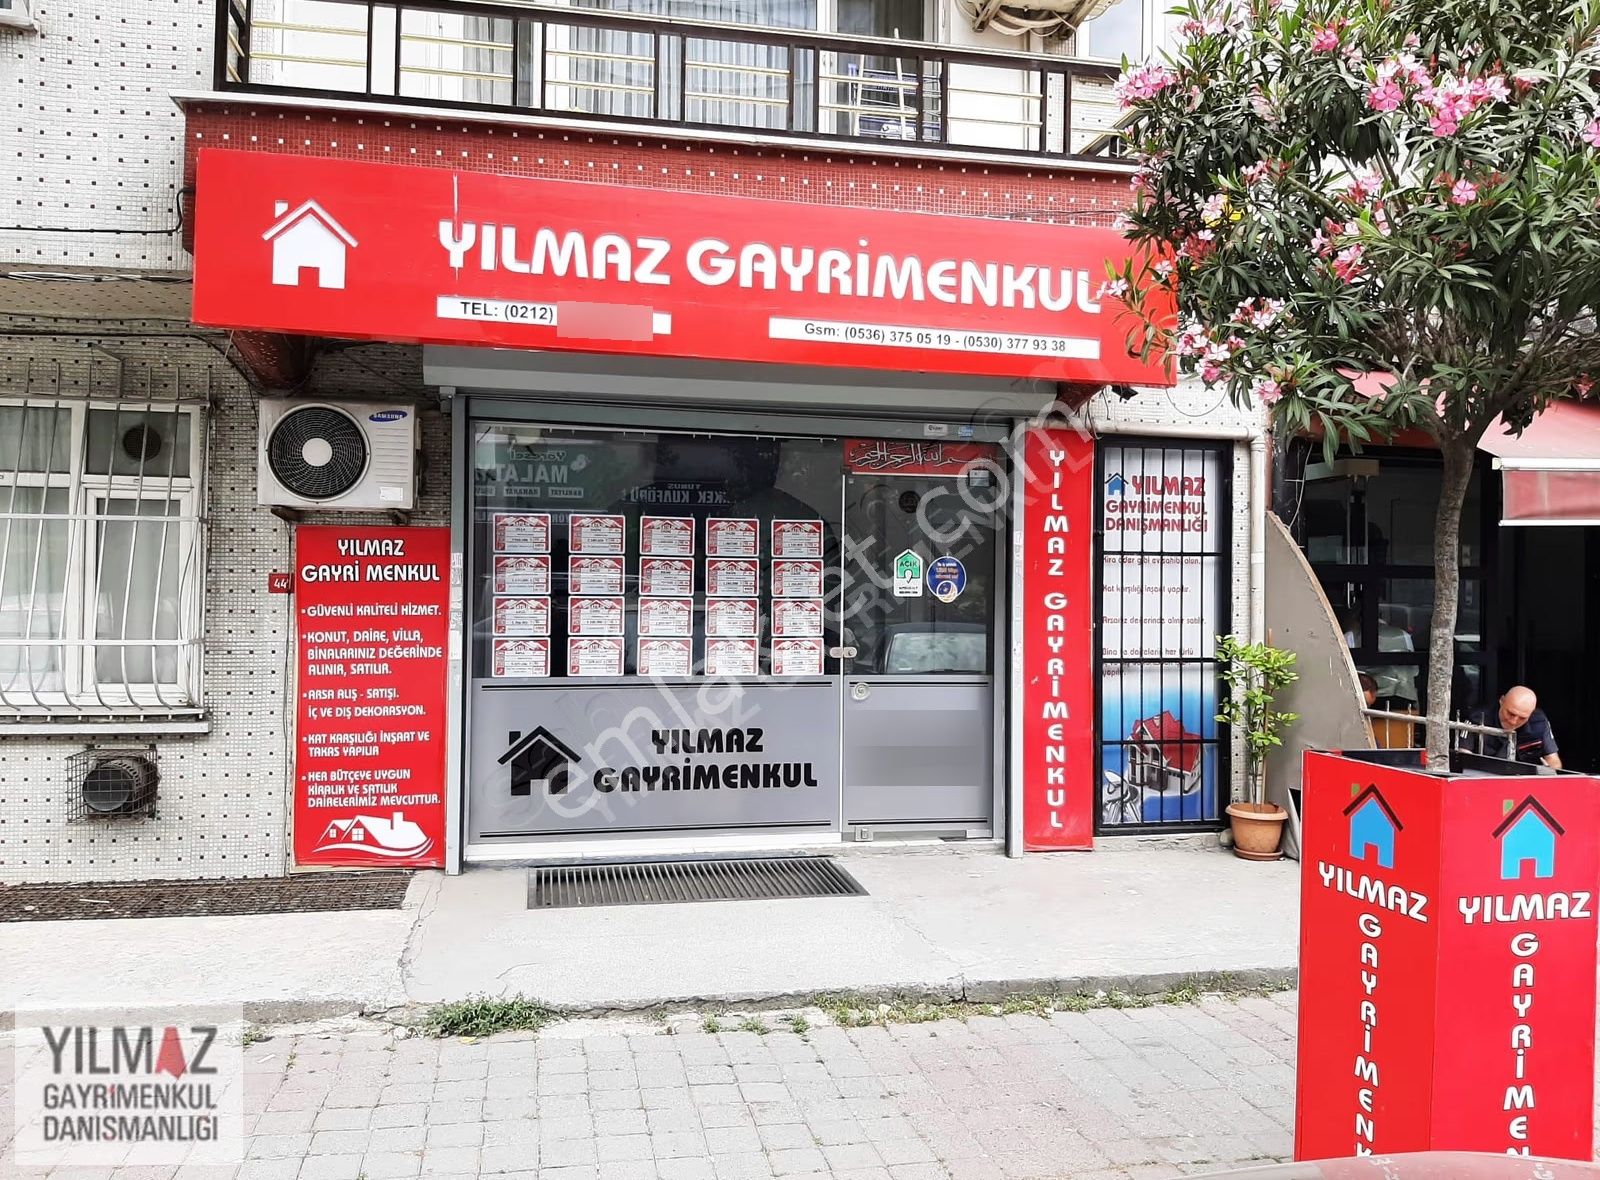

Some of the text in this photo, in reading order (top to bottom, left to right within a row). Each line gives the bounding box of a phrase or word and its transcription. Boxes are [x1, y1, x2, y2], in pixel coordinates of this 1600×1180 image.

[438, 219, 1102, 313] YILMAZ GAYRİMENKUL
[460, 301, 555, 323] TEL: (0212)
[804, 322, 840, 338] Gsm:
[844, 325, 886, 342] (0536)
[889, 329, 913, 344] 375
[917, 332, 932, 346] 05
[937, 332, 952, 347] 19
[963, 336, 1003, 351] (0530)
[1006, 338, 1029, 351] 377
[1032, 339, 1048, 352] 93
[1051, 340, 1066, 353] 38
[1131, 475, 1206, 497] YILMAZ
[1105, 497, 1208, 515] GAYRİMENKUL
[1105, 516, 1208, 535] DANIŞMANLIĞI
[338, 539, 404, 556] YILMAZ
[301, 560, 360, 582] GAYRİ
[366, 564, 440, 582] MENKUL
[274, 578, 288, 589] 44
[307, 602, 442, 616] GÜVENLİ KALİTELİ HİZMET.
[307, 629, 423, 644] KONUT, DAİRE, VİLLA,
[1041, 449, 1071, 829] YILMAZ GAYRİMENKUL
[308, 645, 442, 660] BİNALARINIZ DEĞERİNDE
[351, 664, 392, 675] SATILIR.
[309, 690, 334, 699] ARSA
[338, 689, 357, 701] ALIŞ
[366, 688, 399, 700] SATIŞI.
[308, 705, 425, 719] İÇ VE DIŞ DEKORASYON.
[308, 730, 430, 745] KAT KARŞILIĞI İNŞAAT VE
[652, 728, 764, 754] YILMAZ
[309, 746, 379, 756] TAKAS YAPILIR
[308, 769, 410, 783] HER BÜTÇEYE UYGUN
[593, 758, 818, 793] GAYRİMENKUL
[308, 783, 398, 795] KİRALIK VE SATILIK
[308, 795, 440, 808] DAİRELERİMİZ MEVCUTTUR.
[1318, 860, 1428, 923] YILMAZ
[1458, 892, 1591, 924] YILMAZ
[1503, 932, 1539, 1156] GAYRİME
